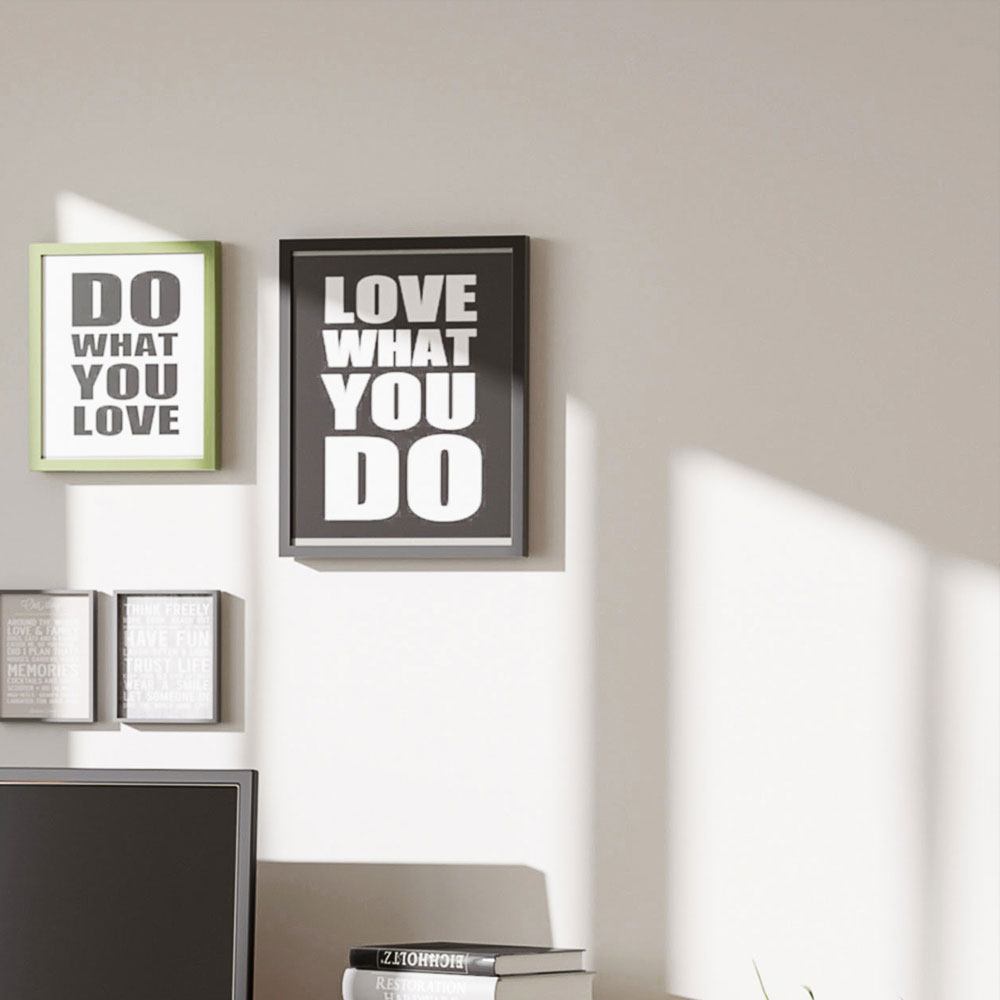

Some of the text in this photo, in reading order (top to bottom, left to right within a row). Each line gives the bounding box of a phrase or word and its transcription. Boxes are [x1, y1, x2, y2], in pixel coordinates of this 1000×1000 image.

[71, 270, 181, 327] DO
[324, 274, 478, 325] LOVE
[71, 333, 178, 358] WHAT
[321, 328, 478, 368] WHAT
[71, 363, 178, 400] YOU
[320, 371, 477, 431] YOU
[73, 405, 180, 436] LOVE
[324, 433, 483, 523] DO
[124, 603, 210, 616] THINK FREELY
[7, 626, 32, 636] LOVE
[124, 630, 210, 647] HAVE FUN
[7, 663, 80, 677] MEMORIES
[123, 658, 210, 673] TRUST LIFE
[376, 976, 466, 994] RESTORATION
